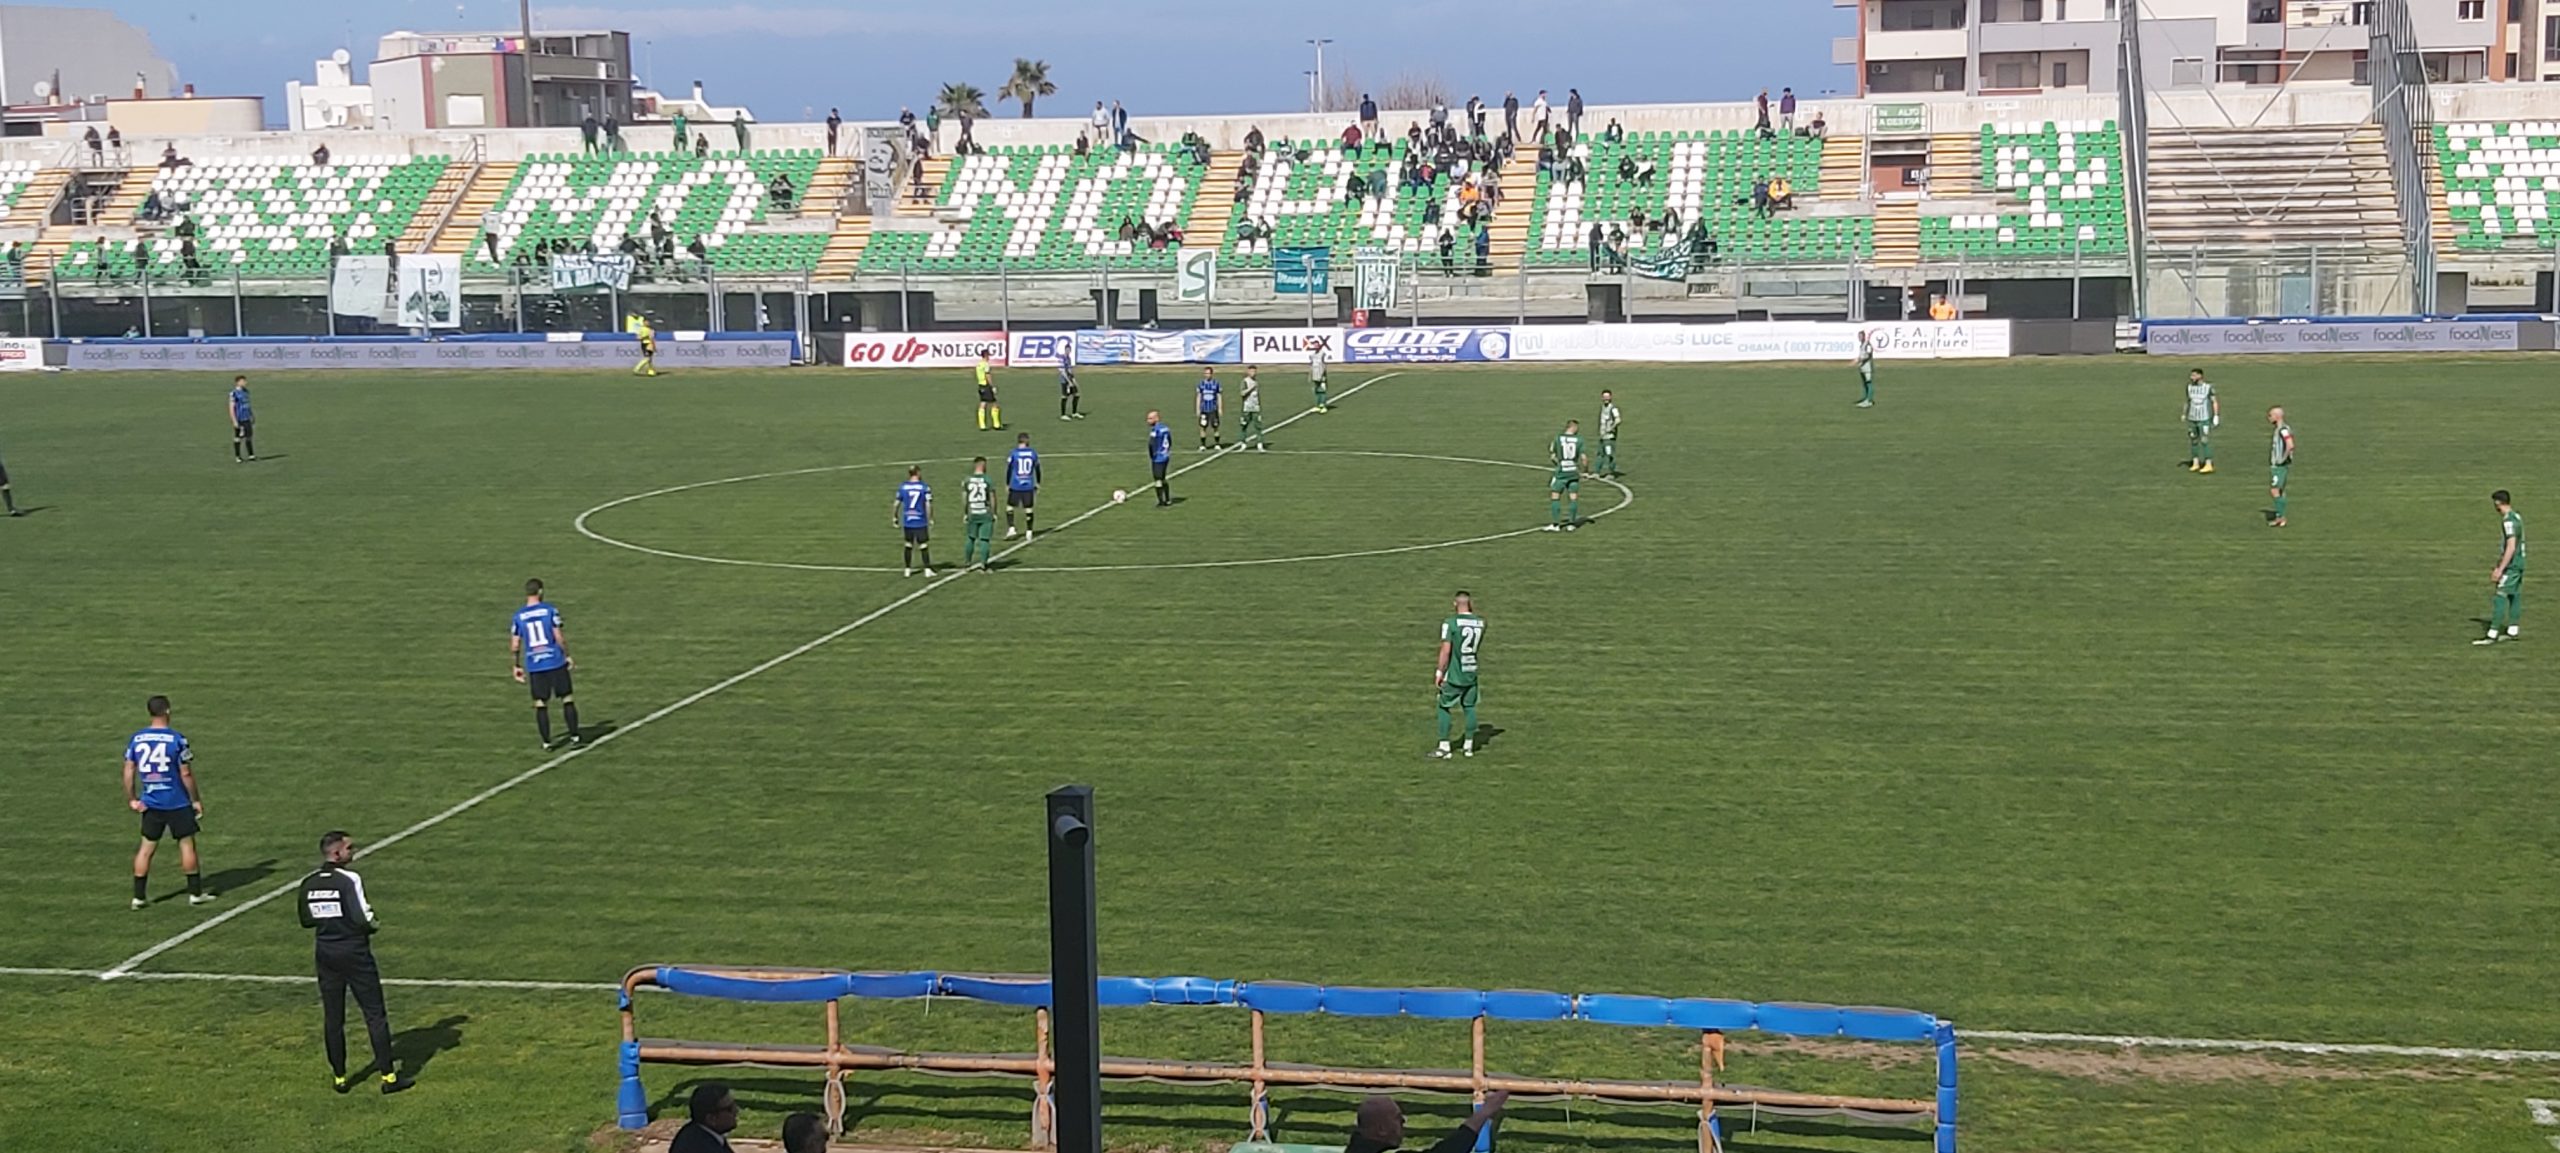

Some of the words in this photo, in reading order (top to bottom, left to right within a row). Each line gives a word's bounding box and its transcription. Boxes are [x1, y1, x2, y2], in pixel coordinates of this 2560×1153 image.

[1253, 334, 1332, 352] PALLEX
[1653, 333, 1684, 346] GAS
[1691, 331, 1734, 346] LUCE
[1737, 342, 1781, 353] CHIAMA
[1813, 340, 1855, 353] 773909
[1893, 338, 1969, 349] Forniture
[850, 342, 890, 362] GO
[891, 336, 929, 362] UP
[931, 342, 1003, 358] NOLEGGI
[1353, 346, 1462, 356] SPORT
[1017, 457, 1033, 475] 10
[908, 490, 921, 509] 7
[967, 482, 988, 502] 23
[526, 620, 549, 647] 11
[1461, 626, 1483, 654] 21
[134, 742, 171, 773] 24
